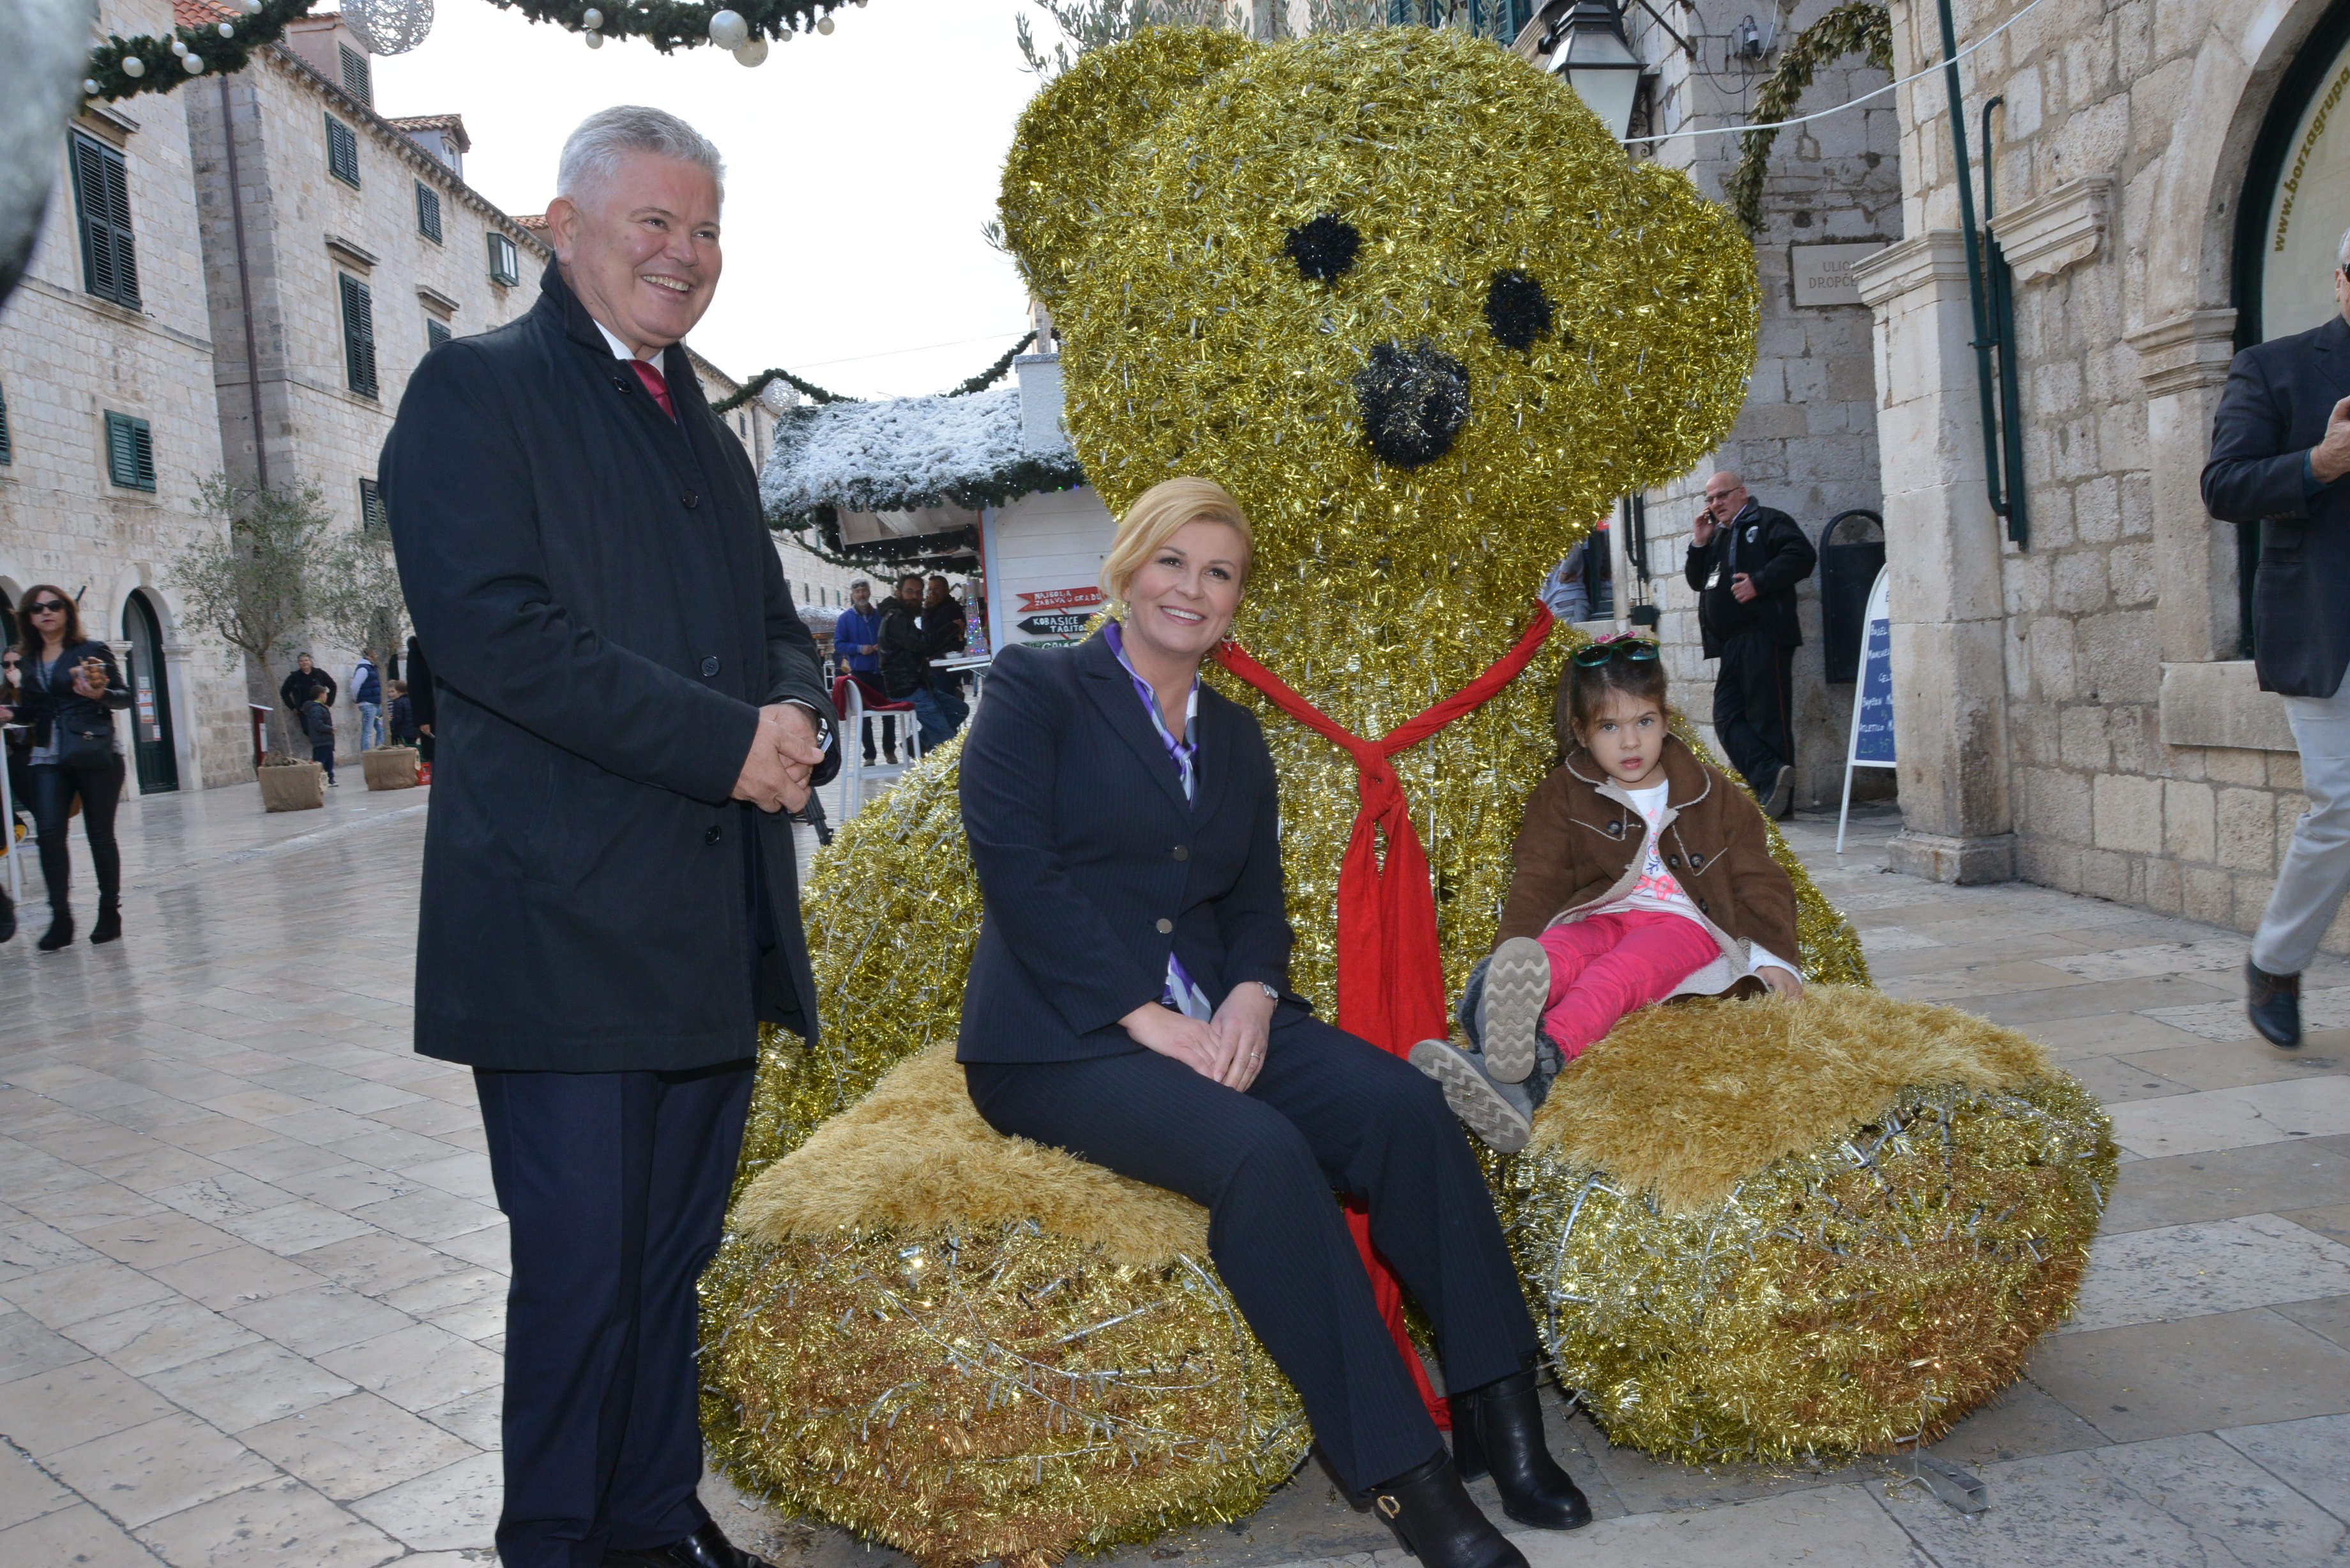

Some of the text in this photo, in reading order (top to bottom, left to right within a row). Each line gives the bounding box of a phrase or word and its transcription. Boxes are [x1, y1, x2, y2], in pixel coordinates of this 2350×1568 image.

[1823, 260, 1856, 272] ULIC
[1035, 597, 1066, 606] ZABAVA
[1033, 616, 1079, 626] KOBASICE
